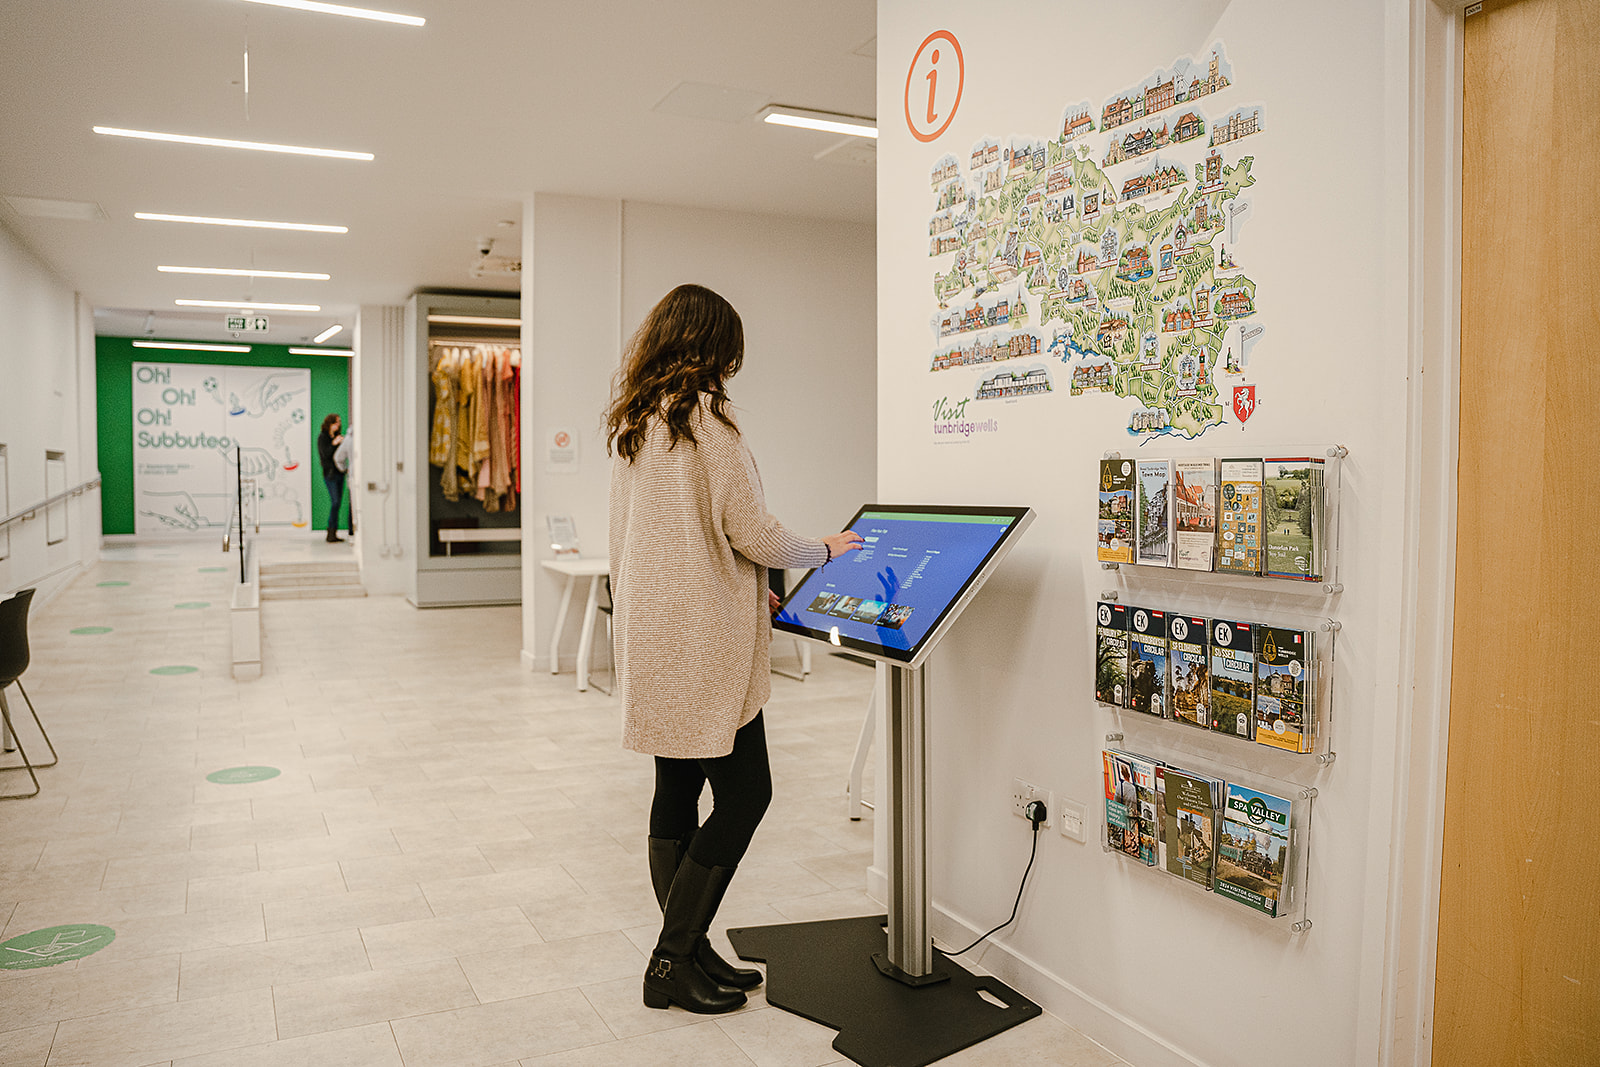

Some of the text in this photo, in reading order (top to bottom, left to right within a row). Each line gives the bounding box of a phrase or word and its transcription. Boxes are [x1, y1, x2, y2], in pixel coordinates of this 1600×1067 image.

[136, 366, 171, 385] Oh!
[162, 388, 196, 406] Oh!
[932, 396, 971, 422] Visit
[137, 408, 172, 426] Oh!
[933, 419, 999, 438] tunbridgewells
[137, 431, 231, 449] Subbuteo
[1100, 608, 1109, 622] EK
[1136, 614, 1146, 628] EK
[1174, 622, 1185, 636] EK
[1218, 627, 1229, 641] EK
[1105, 636, 1126, 648] CIRCULAR
[1143, 644, 1165, 657] CIRCULAR
[1183, 652, 1206, 665] CIRCULAR
[1225, 660, 1250, 672] CIRCULAR
[1233, 801, 1281, 822] SPA VALLEY
[1230, 886, 1248, 896] VISITOR
[1247, 892, 1262, 902] GUIDE
